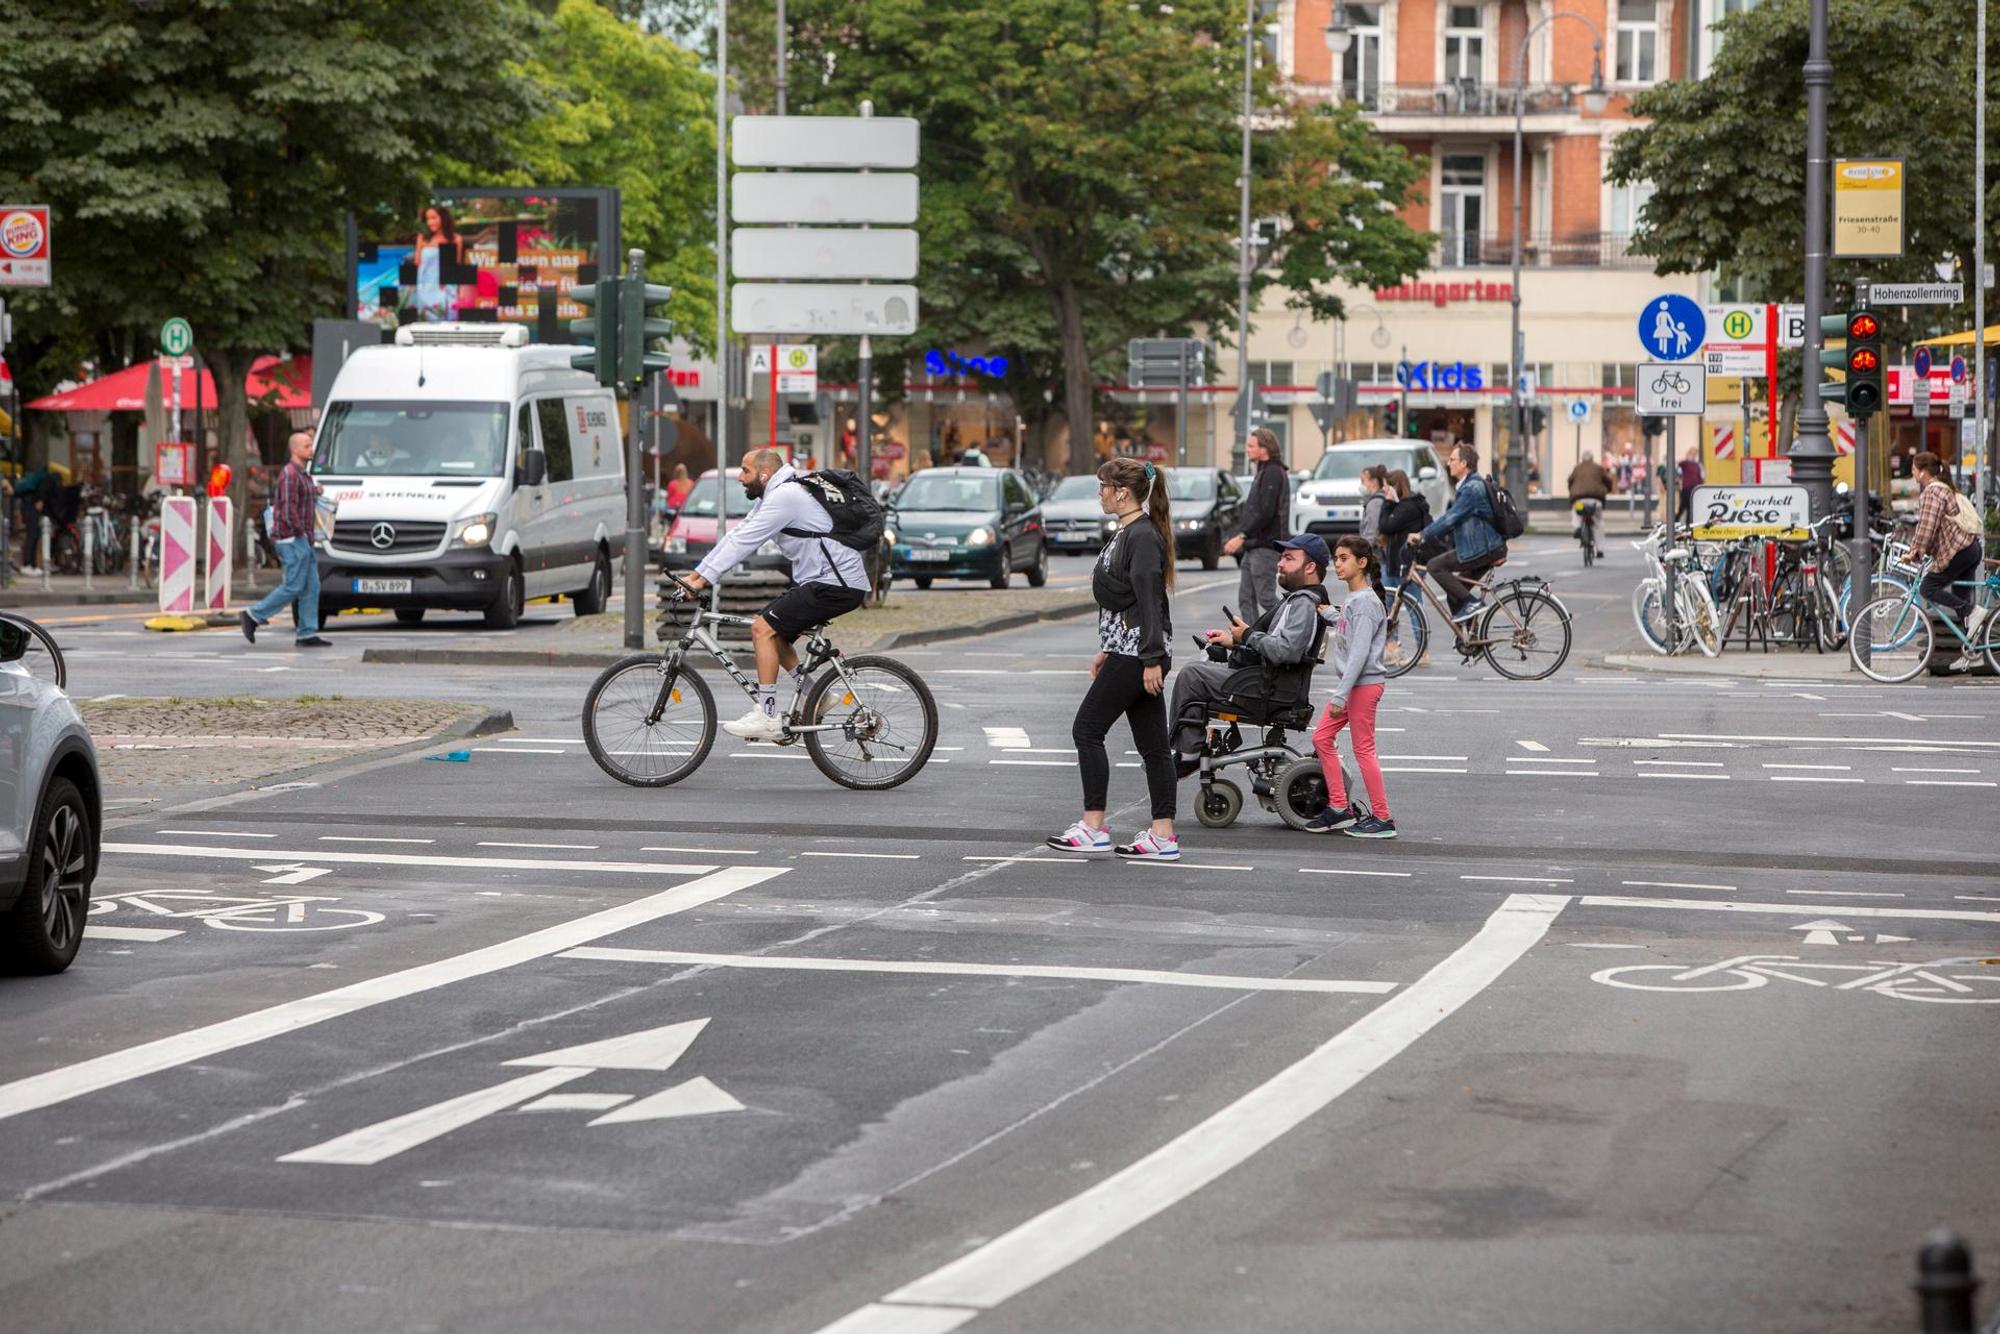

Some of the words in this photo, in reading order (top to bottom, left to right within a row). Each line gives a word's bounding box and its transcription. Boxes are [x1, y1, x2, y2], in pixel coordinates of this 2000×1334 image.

[1838, 215, 1899, 224] Friesenstraße
[7, 229, 38, 247] KING
[468, 252, 497, 267] Wir
[552, 253, 580, 267] uns
[1874, 287, 1960, 301] Hohenzollernring
[1731, 316, 1745, 334] H
[1789, 318, 1805, 338] B
[170, 328, 183, 347] H
[754, 353, 766, 367] A
[1405, 360, 1483, 391] Kids
[1660, 397, 1682, 409] frei
[1713, 490, 1736, 501] der
[1744, 495, 1793, 508] parkett
[1706, 502, 1780, 524] Riese
